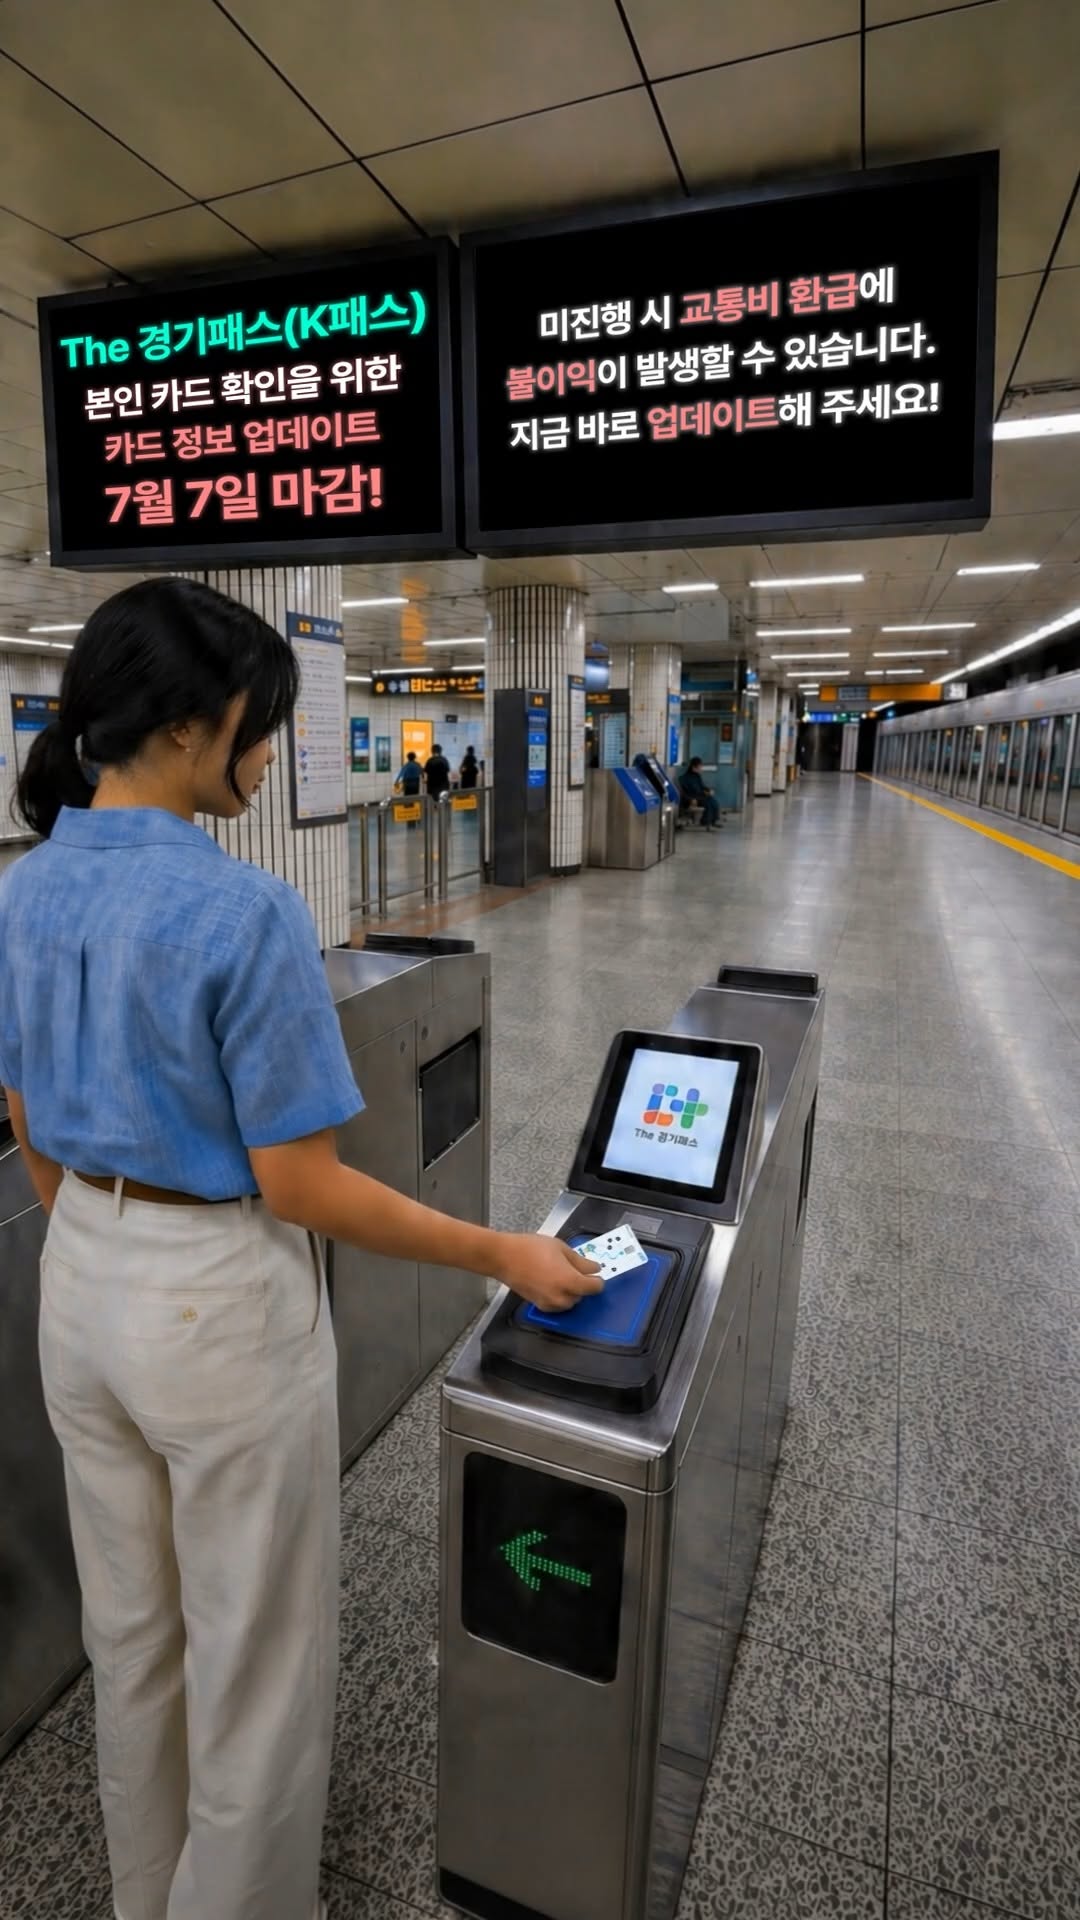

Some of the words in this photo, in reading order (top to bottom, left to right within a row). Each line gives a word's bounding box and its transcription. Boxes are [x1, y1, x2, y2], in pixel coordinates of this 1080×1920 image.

[60, 335, 130, 368] The
[138, 290, 426, 361] 경기패스(K패스)
[540, 300, 631, 342] 미진행
[639, 295, 671, 330] 시
[679, 281, 779, 324] 교통비
[788, 266, 894, 314] 환급에
[84, 382, 143, 421] 본인
[151, 377, 215, 412] 카드
[221, 364, 322, 405] 확인을
[329, 353, 402, 395] 위한
[506, 355, 626, 401] 불이익이
[636, 343, 735, 387] 발생할
[741, 340, 776, 376] 수
[784, 322, 936, 372] 있습니다.
[105, 431, 166, 465] 카드
[172, 424, 237, 460] 정보
[243, 411, 381, 454] 업데이트
[510, 416, 571, 451] 지금
[578, 410, 640, 445] 바로
[647, 391, 812, 440] 업데이트해
[820, 382, 939, 424] 주세요!
[104, 478, 174, 525] 7월
[185, 472, 259, 520] 7일
[272, 464, 382, 516] 마감!
[635, 1127, 654, 1140] The
[658, 1131, 698, 1148] 경기패스
